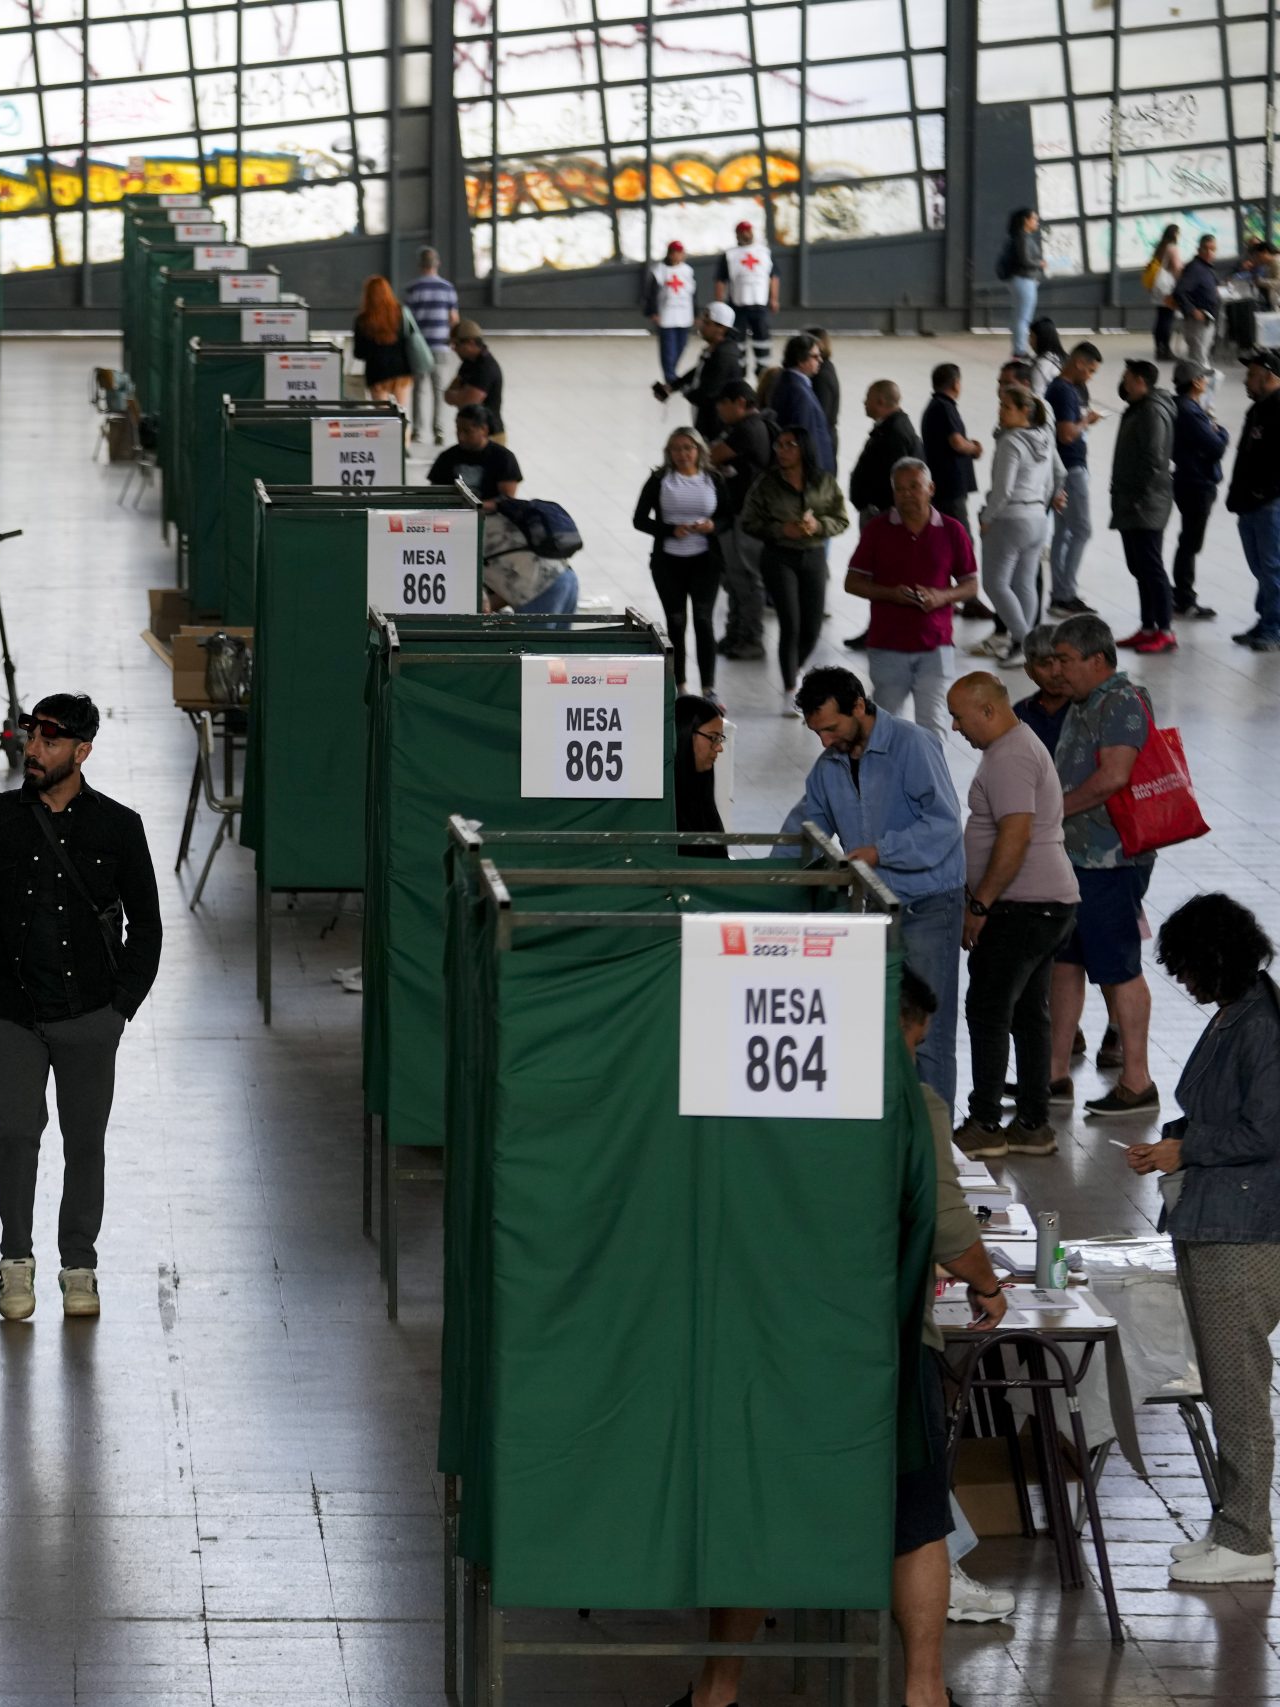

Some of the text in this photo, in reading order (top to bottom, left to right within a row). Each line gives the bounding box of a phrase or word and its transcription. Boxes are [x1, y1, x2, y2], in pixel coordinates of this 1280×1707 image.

[287, 381, 317, 390] MESA
[340, 451, 375, 463] MESA
[403, 550, 446, 565] MESA
[403, 573, 446, 604] 866
[567, 708, 622, 731] MESA
[566, 741, 623, 781] 865
[745, 988, 827, 1024] MESA
[746, 1036, 827, 1092] 864
